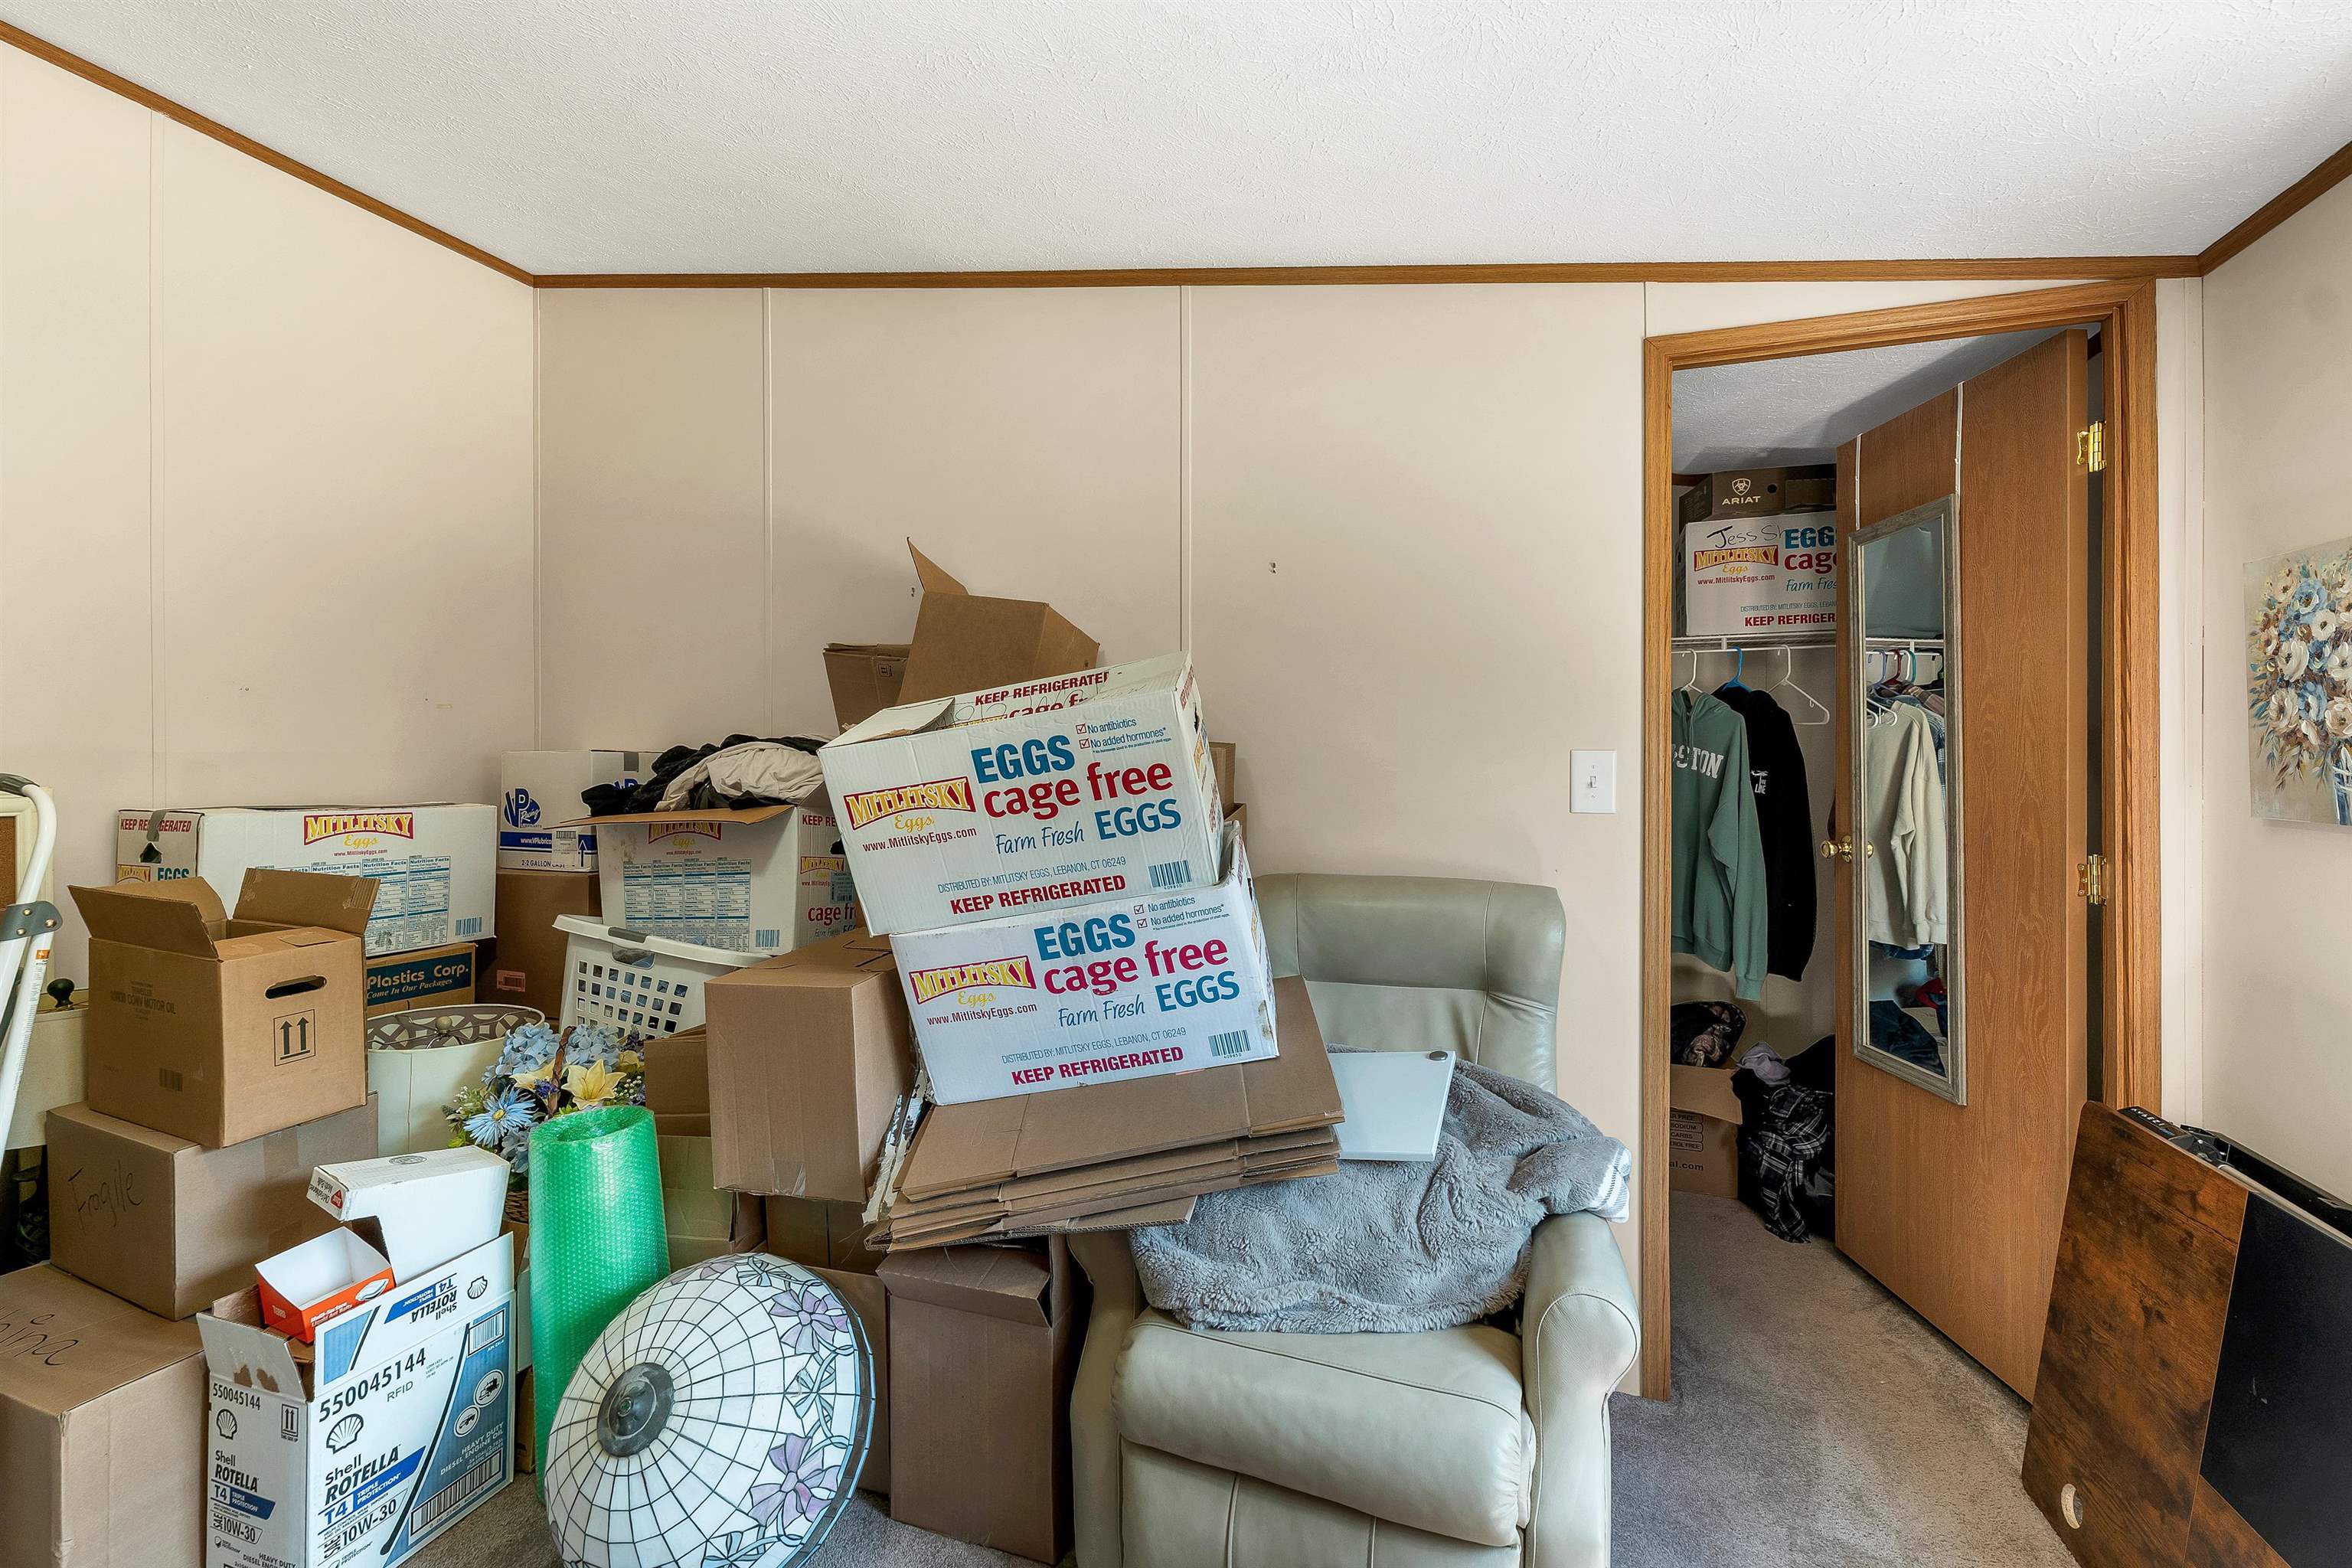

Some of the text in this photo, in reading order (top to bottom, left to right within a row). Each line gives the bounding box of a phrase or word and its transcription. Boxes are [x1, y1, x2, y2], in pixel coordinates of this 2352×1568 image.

[1722, 496, 1761, 505] ARIAT
[1707, 525, 1757, 548] Jess
[1785, 526, 1837, 549] EGG
[1696, 547, 1777, 570] MITLITSKY
[1723, 564, 1749, 574] Eggs
[1697, 574, 1775, 585] www.MitlitskyEggs.com
[1786, 579, 1813, 591] Farm
[1778, 603, 1802, 611] MITLITSKY
[1745, 612, 1837, 627] KEEP REFRIGER
[975, 690, 1009, 706] KEEP
[1087, 718, 1137, 734] No antibiotics
[1090, 738, 1101, 749] No
[1102, 733, 1125, 747] added
[970, 735, 1075, 784] EGGS
[845, 778, 970, 827] MITLITSKY
[984, 762, 1173, 821] cage free
[505, 788, 530, 828] VP
[120, 818, 192, 832] KEEP REGERATED
[306, 814, 412, 842] MITLITSKY
[802, 814, 823, 826] KEEP
[894, 814, 935, 833] Eggs
[995, 833, 1037, 854] Farm
[1041, 821, 1084, 848] Fresh
[1094, 799, 1181, 841] EGGS
[344, 834, 379, 849] Eggs
[863, 827, 977, 852] www.MitlitskyEggs.com
[937, 855, 1126, 893] DISTRIBUTED BY: MITLITSKY EGGS, LEBANON, CT 06249
[949, 874, 1127, 915] KEEP REFRIGERATED
[1148, 896, 1196, 912] No antibiotics
[808, 906, 841, 926] cage
[1150, 916, 1161, 926] No
[1162, 912, 1185, 925] added
[1034, 913, 1135, 962] EGGS
[367, 963, 469, 990] Plastics Corp.
[1044, 939, 1228, 996] cage free
[367, 990, 389, 999] Come
[390, 987, 399, 995] In
[420, 978, 452, 989] Packages
[911, 959, 1031, 1001] MITLITSKY
[957, 990, 997, 1008] Eggs
[1058, 971, 1240, 1027] Farm Fresh EGGS
[927, 1003, 1037, 1025] www.MitlitskyEggs.com
[1001, 1027, 1187, 1064] DISTRIBUTED BY: MITLITSKY EGGS, LEBANON, CT 06249
[1011, 1046, 1184, 1085] KEEP REFRIGERATED
[68, 1160, 142, 1235] Fragile
[439, 1277, 454, 1294] T4
[410, 1290, 458, 1324] ROTELLA
[436, 1302, 458, 1321] Shell
[213, 1383, 261, 1410] 550045144
[318, 1348, 426, 1423] 550045144
[387, 1380, 413, 1402] RFID
[462, 1422, 504, 1455] HEAVY DUTY
[215, 1449, 236, 1467] Shell
[440, 1429, 504, 1475] DIESEL ENGINE OIL
[214, 1463, 258, 1493] ROTELLA
[325, 1454, 361, 1486] Shell
[325, 1446, 399, 1506] ROTELLA
[214, 1484, 227, 1501] T4
[357, 1480, 380, 1498] TRIPLE
[358, 1472, 402, 1506] PROTECTION
[325, 1501, 348, 1525] T4
[214, 1512, 256, 1542] SAE 10W-30
[324, 1535, 341, 1559] SAE
[343, 1498, 397, 1546] 10W-30
[243, 1554, 260, 1566] DIESEL
[259, 1553, 278, 1565] HEAVY
[279, 1560, 296, 1568] DUTY
